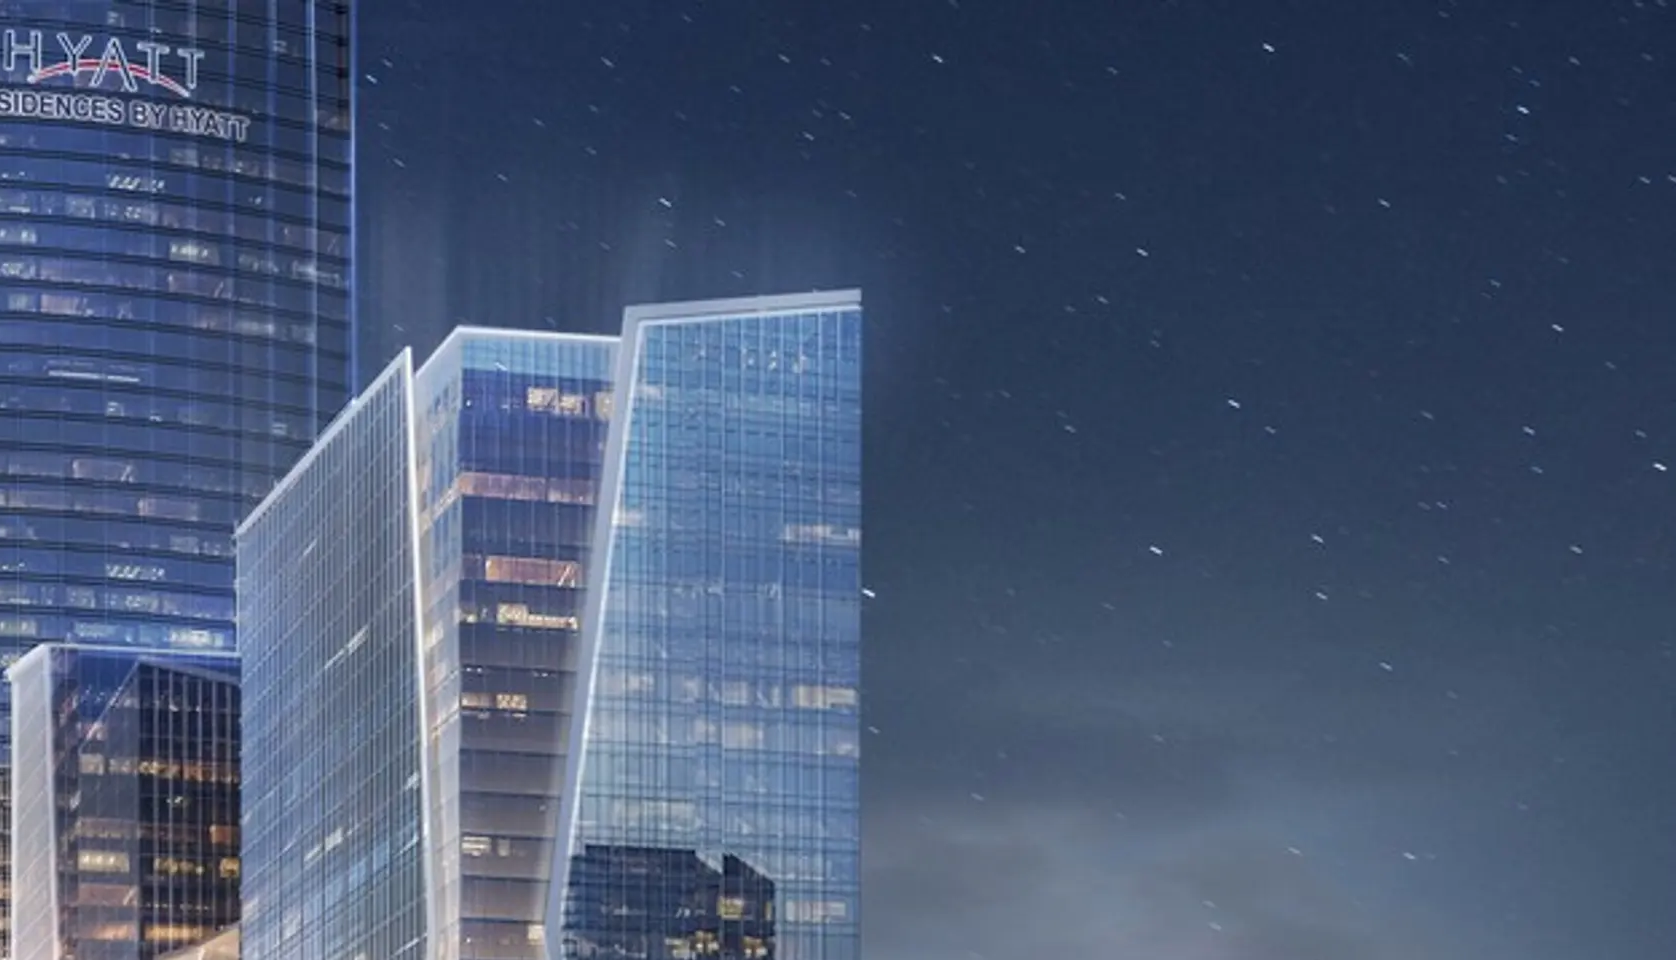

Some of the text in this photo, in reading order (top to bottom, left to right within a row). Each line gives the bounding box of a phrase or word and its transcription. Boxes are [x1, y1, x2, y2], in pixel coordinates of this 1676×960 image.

[2, 29, 205, 92] HYATT
[129, 101, 165, 127] BY
[169, 107, 251, 143] HYATT
